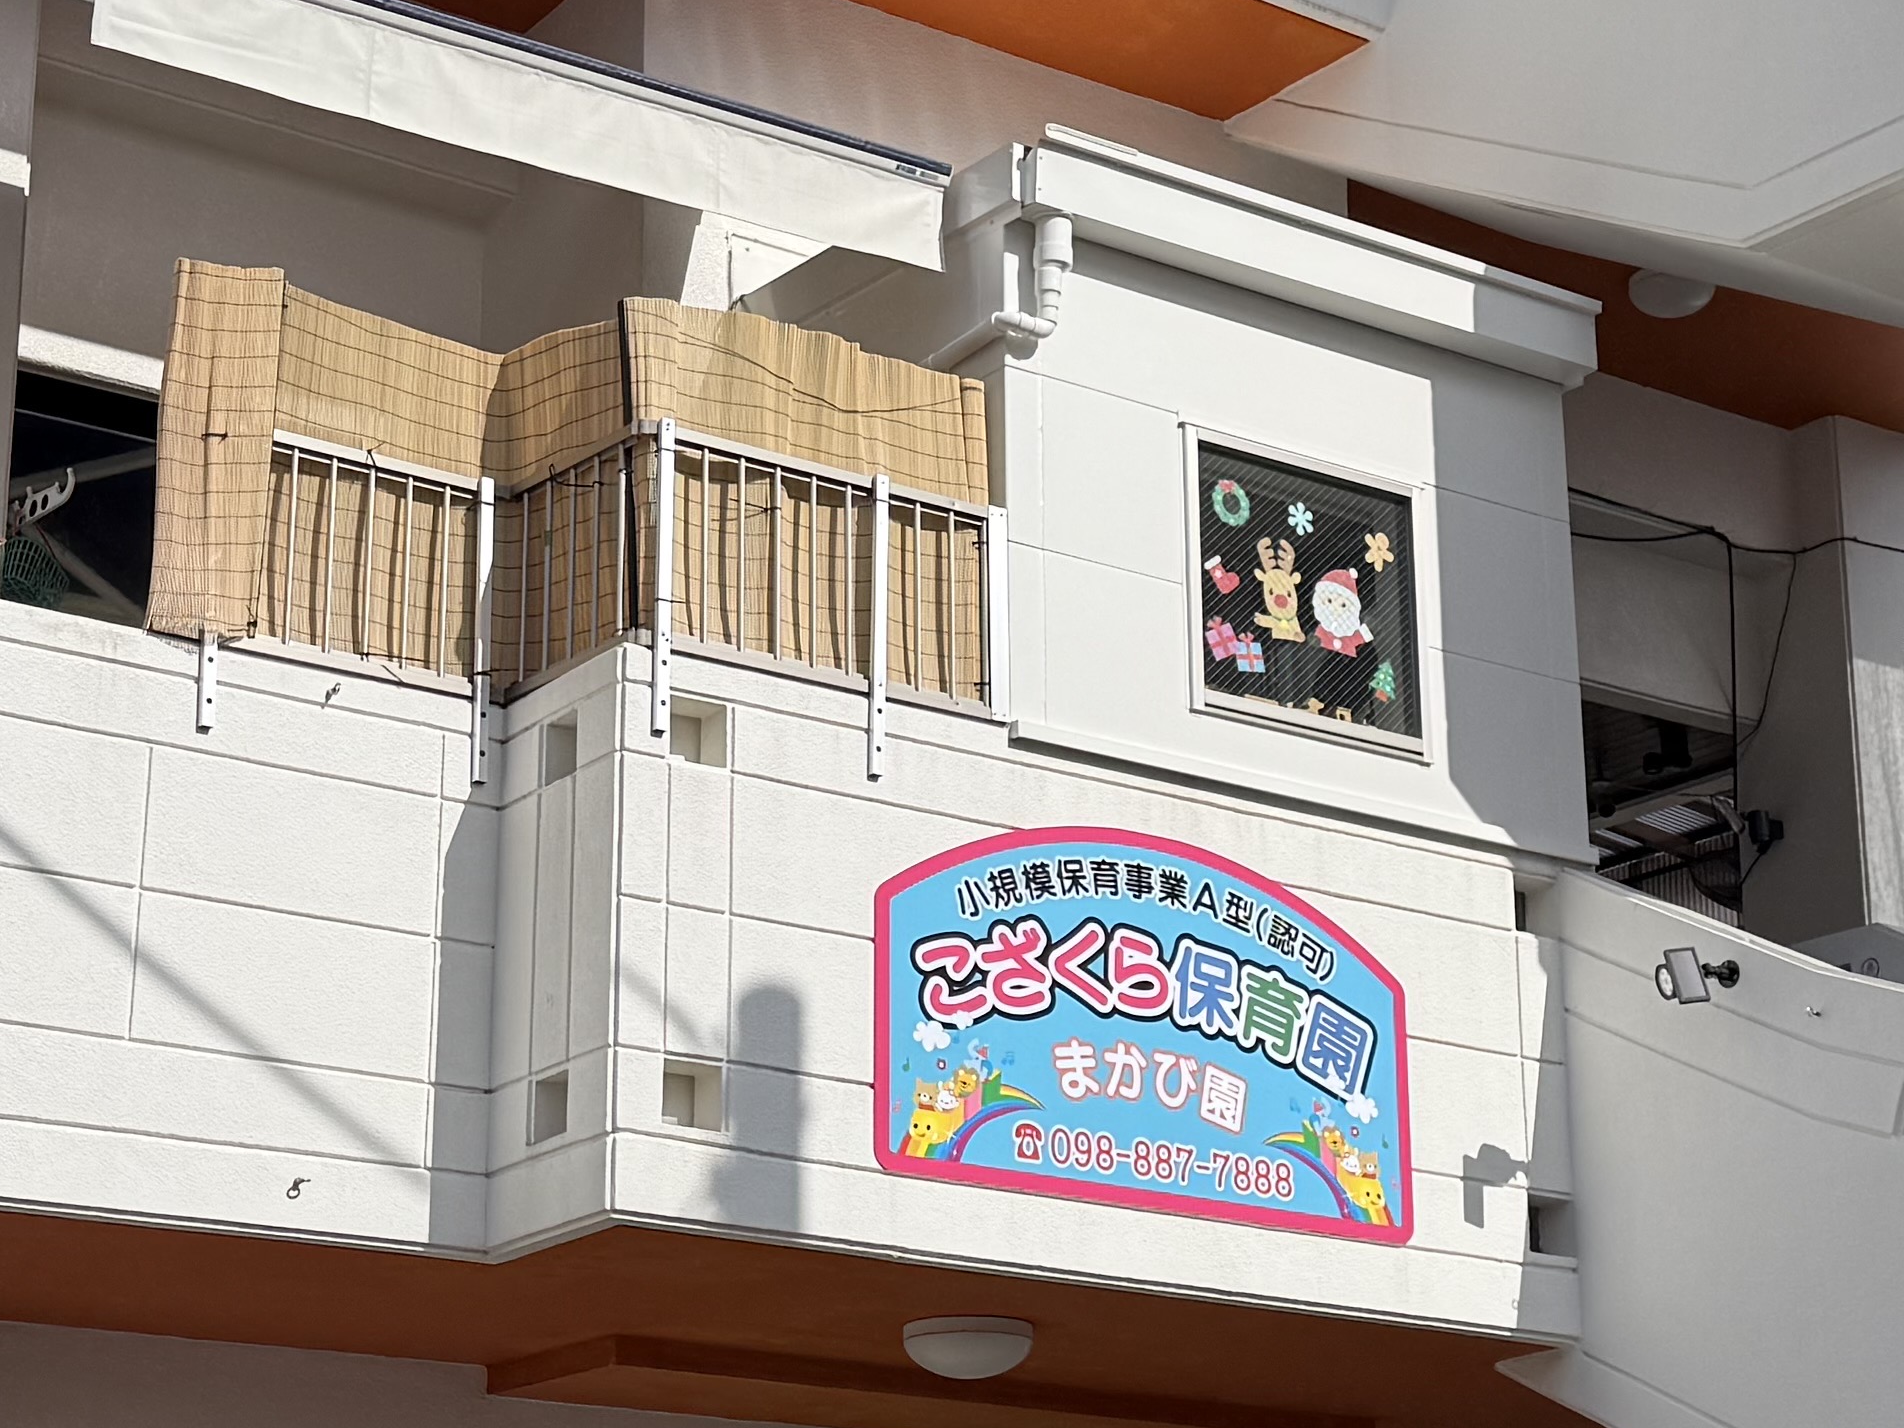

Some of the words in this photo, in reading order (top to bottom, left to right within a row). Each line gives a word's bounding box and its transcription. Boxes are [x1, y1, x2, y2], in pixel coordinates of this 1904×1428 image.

[916, 921, 1371, 1098] こざくら保育園
[1053, 1038, 1247, 1134] まかび園
[1050, 1127, 1293, 1199] 098-887-7888
